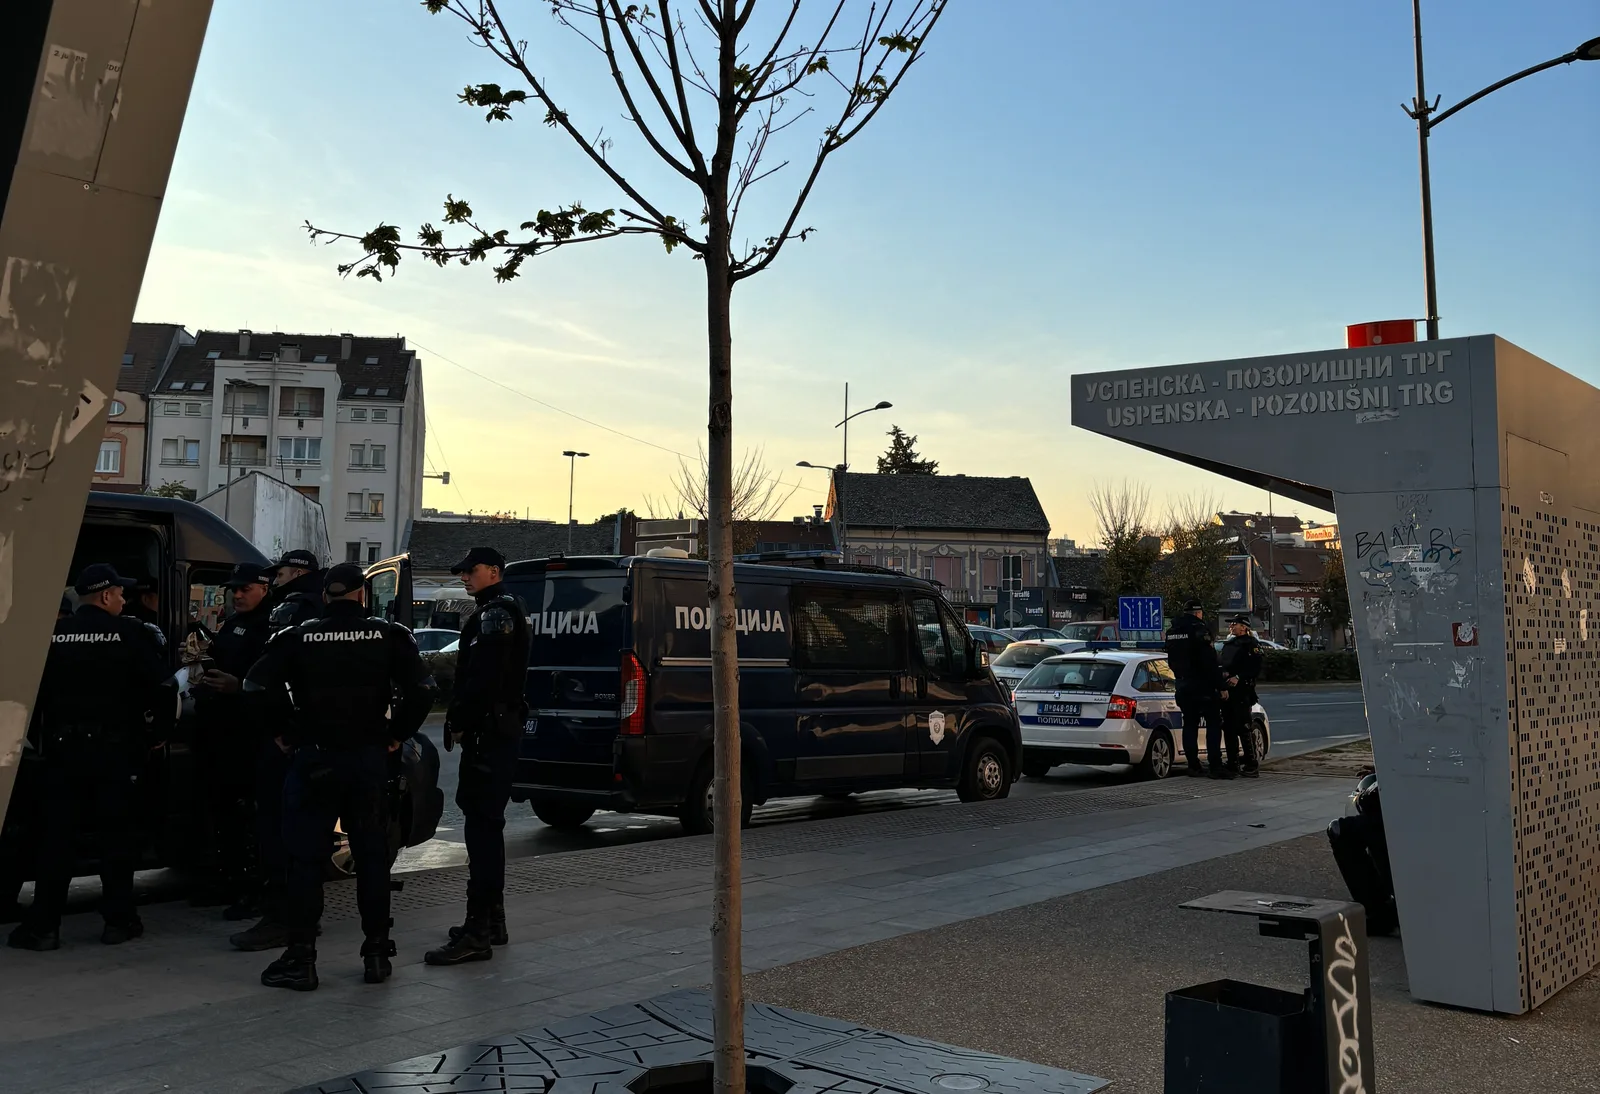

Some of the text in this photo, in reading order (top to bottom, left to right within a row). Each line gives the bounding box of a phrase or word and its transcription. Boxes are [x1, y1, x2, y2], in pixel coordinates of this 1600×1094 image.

[1086, 373, 1206, 402] УСПЕНСКА
[1227, 355, 1393, 390] ПОЗОРИШНИ
[1401, 350, 1452, 375] ТРГ
[1106, 399, 1230, 427] USPENSKA
[1252, 383, 1390, 417] POZORIŠNI
[1398, 381, 1454, 406] TRG
[1305, 530, 1332, 540] Dinamika
[675, 606, 785, 635] ПОЦИЈА
[303, 630, 383, 643] ПОЛИЦИЈА
[1037, 716, 1081, 725] ПОЛИЦИЈА
